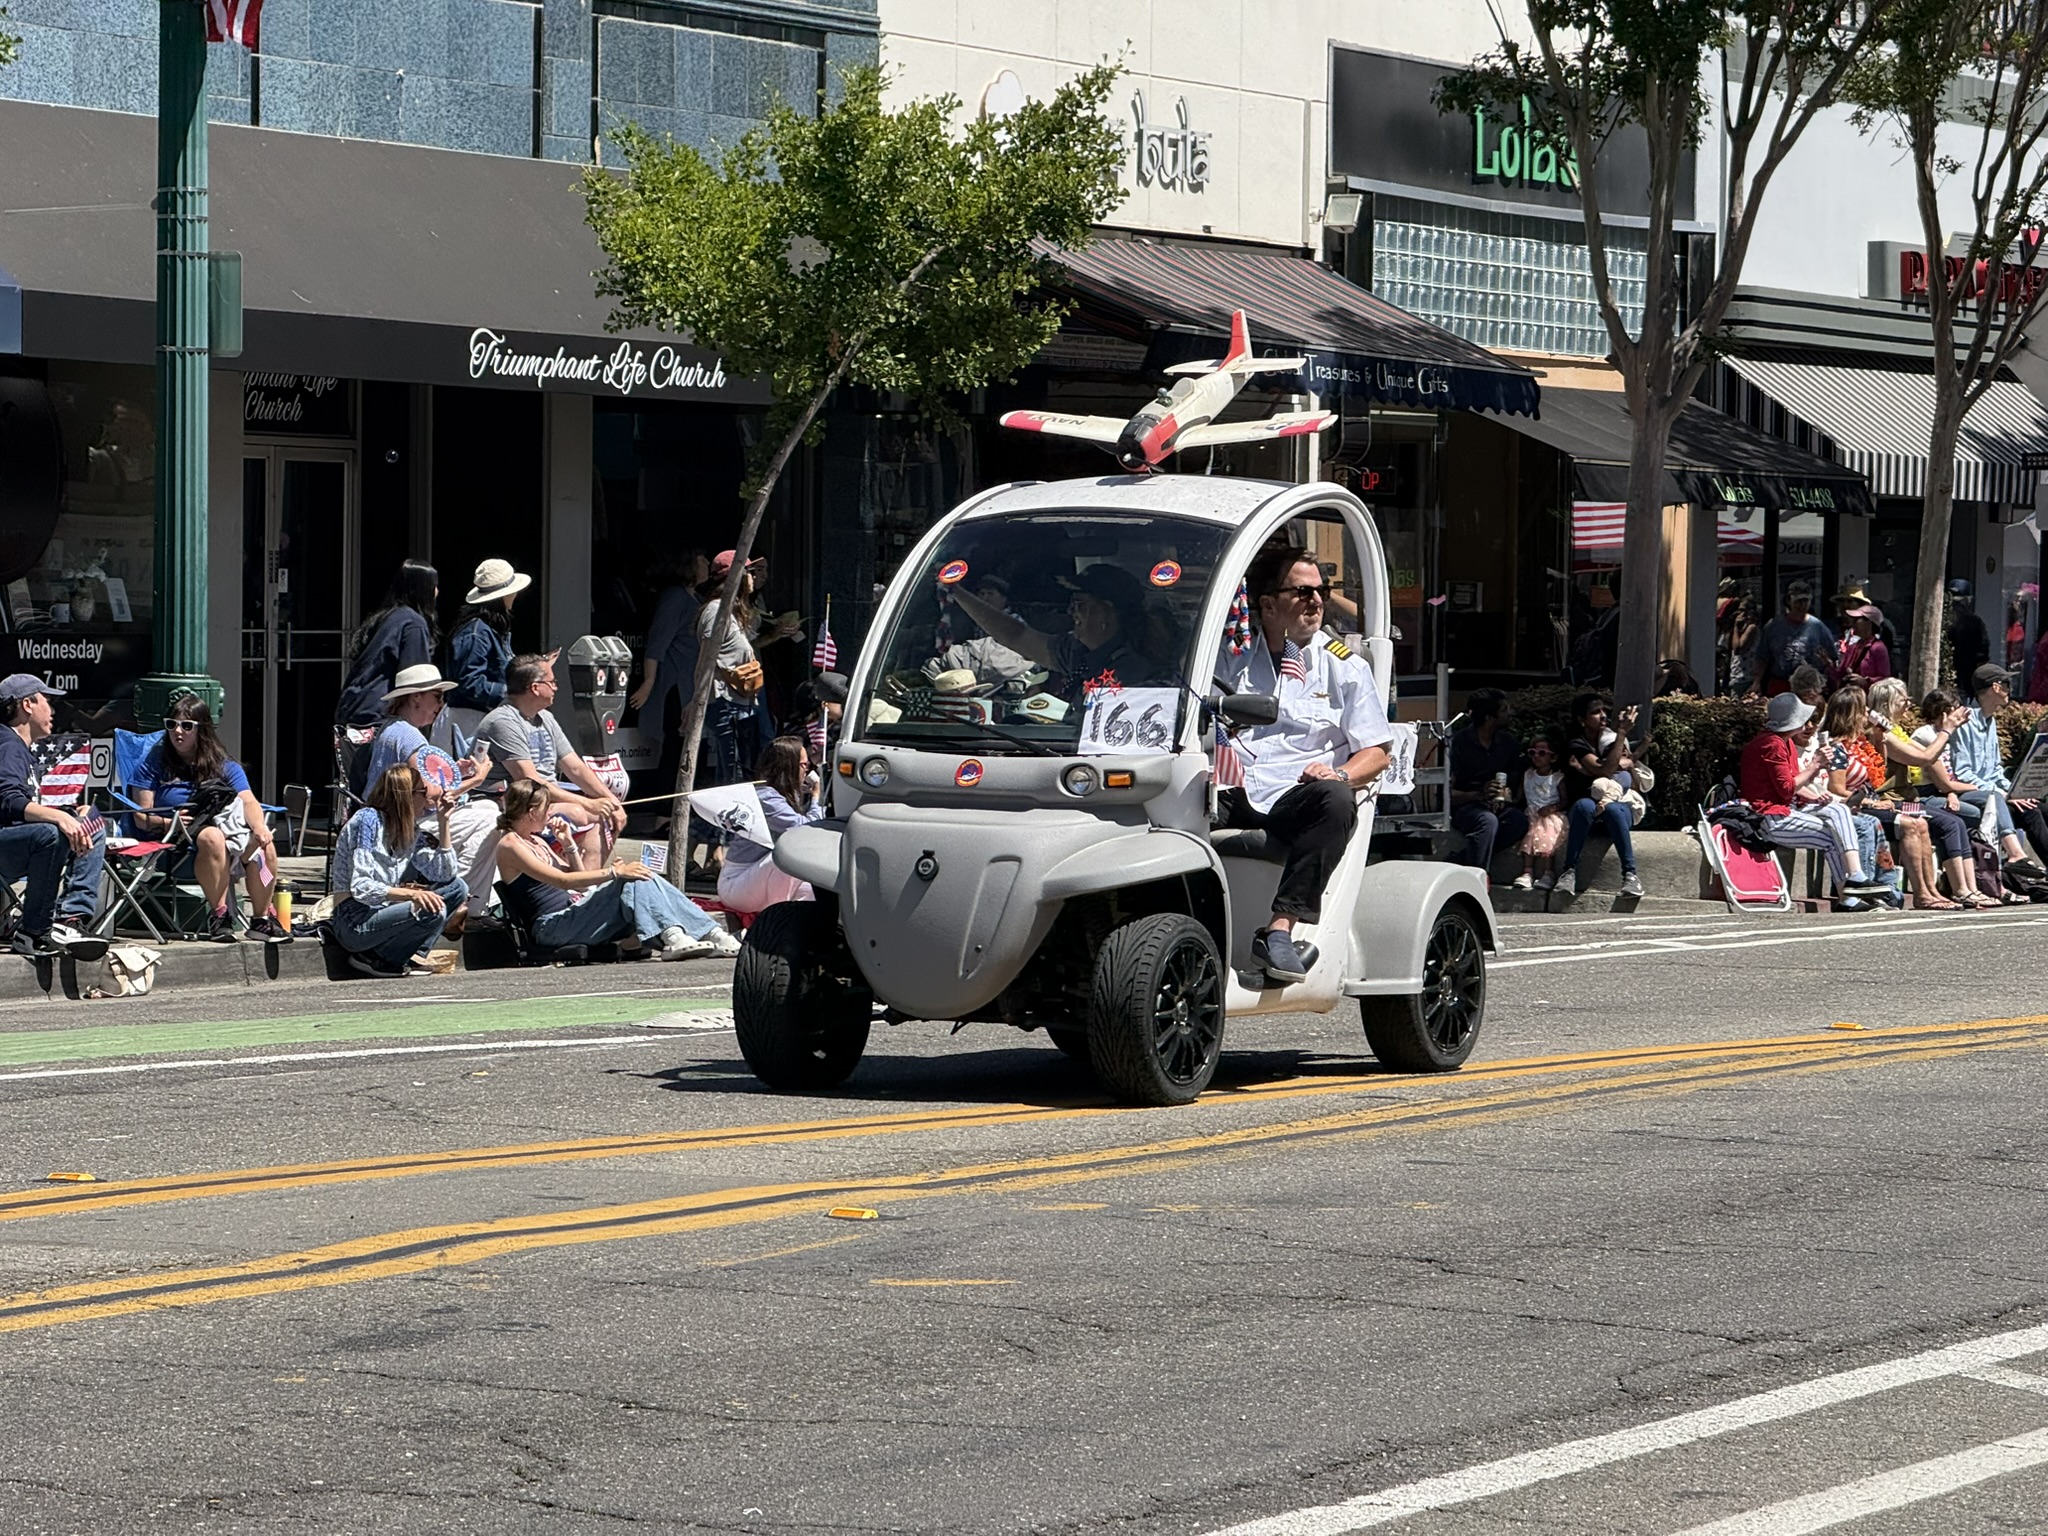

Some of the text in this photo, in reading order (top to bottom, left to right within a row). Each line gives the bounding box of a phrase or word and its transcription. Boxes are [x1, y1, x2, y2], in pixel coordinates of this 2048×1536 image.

[1476, 93, 1579, 187] Lolas
[469, 327, 726, 395] Triumphant Life Church
[1304, 353, 1361, 382] Treasures
[1376, 362, 1415, 398] Unique
[1418, 367, 1449, 395] Gifts
[245, 390, 304, 421] Church
[17, 638, 104, 664] Wednesday
[43, 670, 79, 691] 7 pm
[1090, 701, 1168, 748] 166
